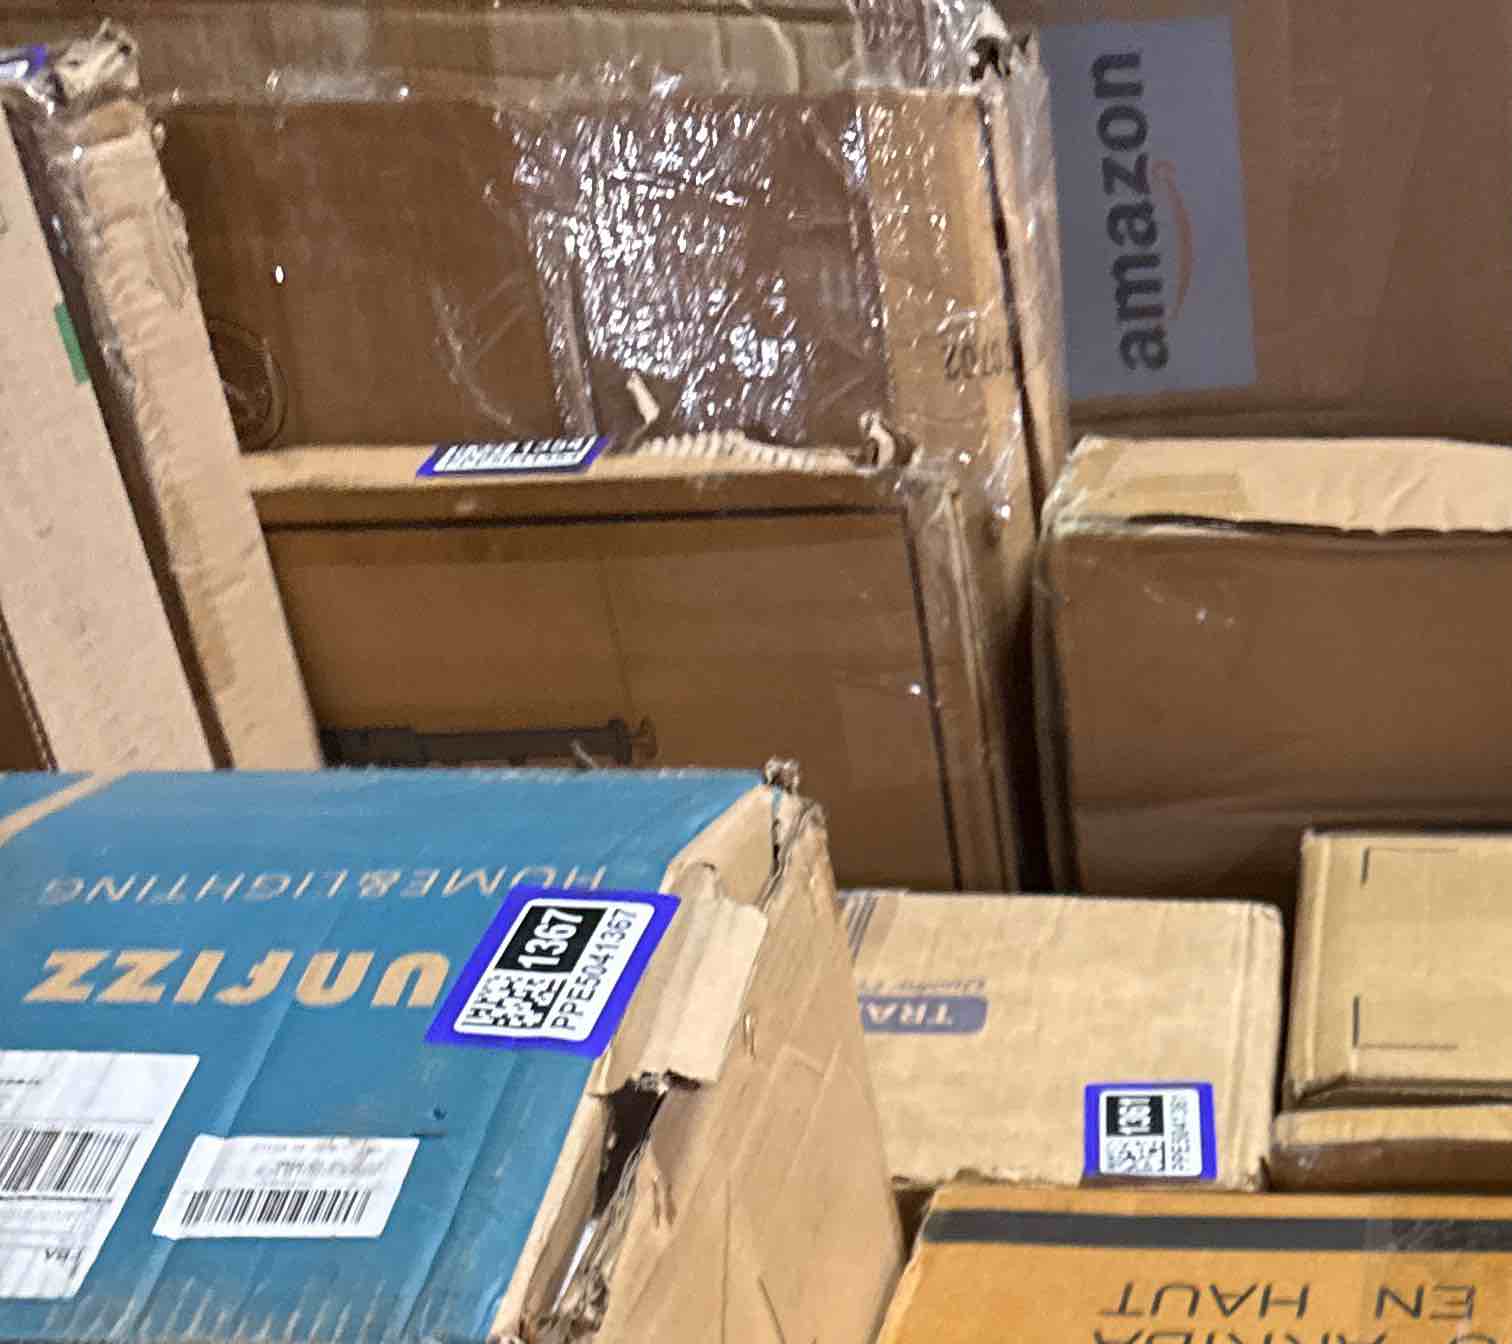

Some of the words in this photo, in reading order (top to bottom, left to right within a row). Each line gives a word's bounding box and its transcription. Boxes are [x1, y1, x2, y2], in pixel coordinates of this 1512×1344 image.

[1090, 49, 1170, 372] amazon
[517, 907, 584, 969] 1367
[550, 907, 638, 1031] PPE5041367
[1100, 1282, 1310, 1319] HAUT
[1375, 1284, 1477, 1321] EN
